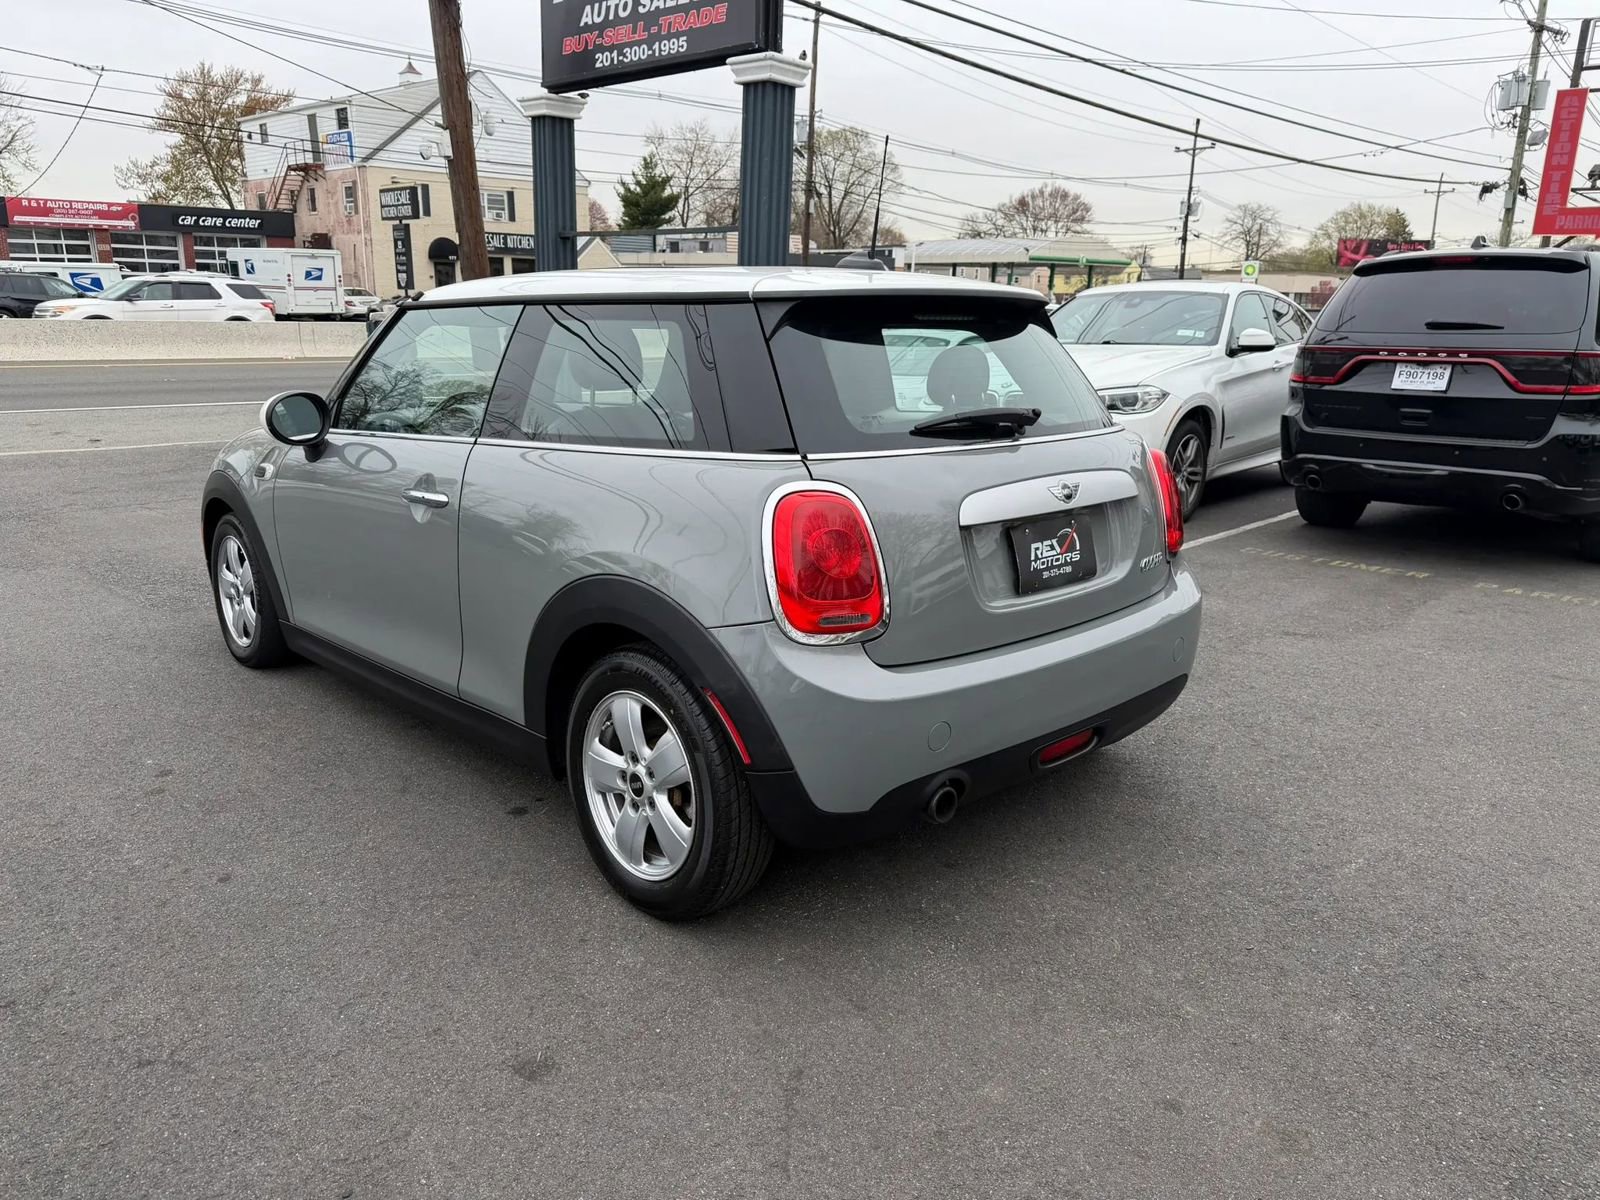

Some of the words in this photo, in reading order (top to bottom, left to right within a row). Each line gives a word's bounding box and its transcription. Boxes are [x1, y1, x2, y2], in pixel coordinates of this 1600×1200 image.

[579, 0, 632, 26] AUTO
[638, 0, 698, 13] SAL
[595, 37, 688, 68] 201-300-1995
[1552, 95, 1580, 165] ACTION
[381, 189, 411, 206] WHOLESALE
[72, 202, 108, 210] REPAIRS
[382, 207, 397, 217] KITCHEN
[178, 215, 197, 225] car
[199, 216, 223, 226] care
[225, 217, 261, 228] center
[1554, 215, 1600, 229] PARKI
[485, 233, 505, 248] ESALE
[507, 235, 535, 249] KITCHEN
[1398, 370, 1446, 381] F907198
[1031, 537, 1065, 560] REV
[1031, 551, 1080, 571] MOTORS
